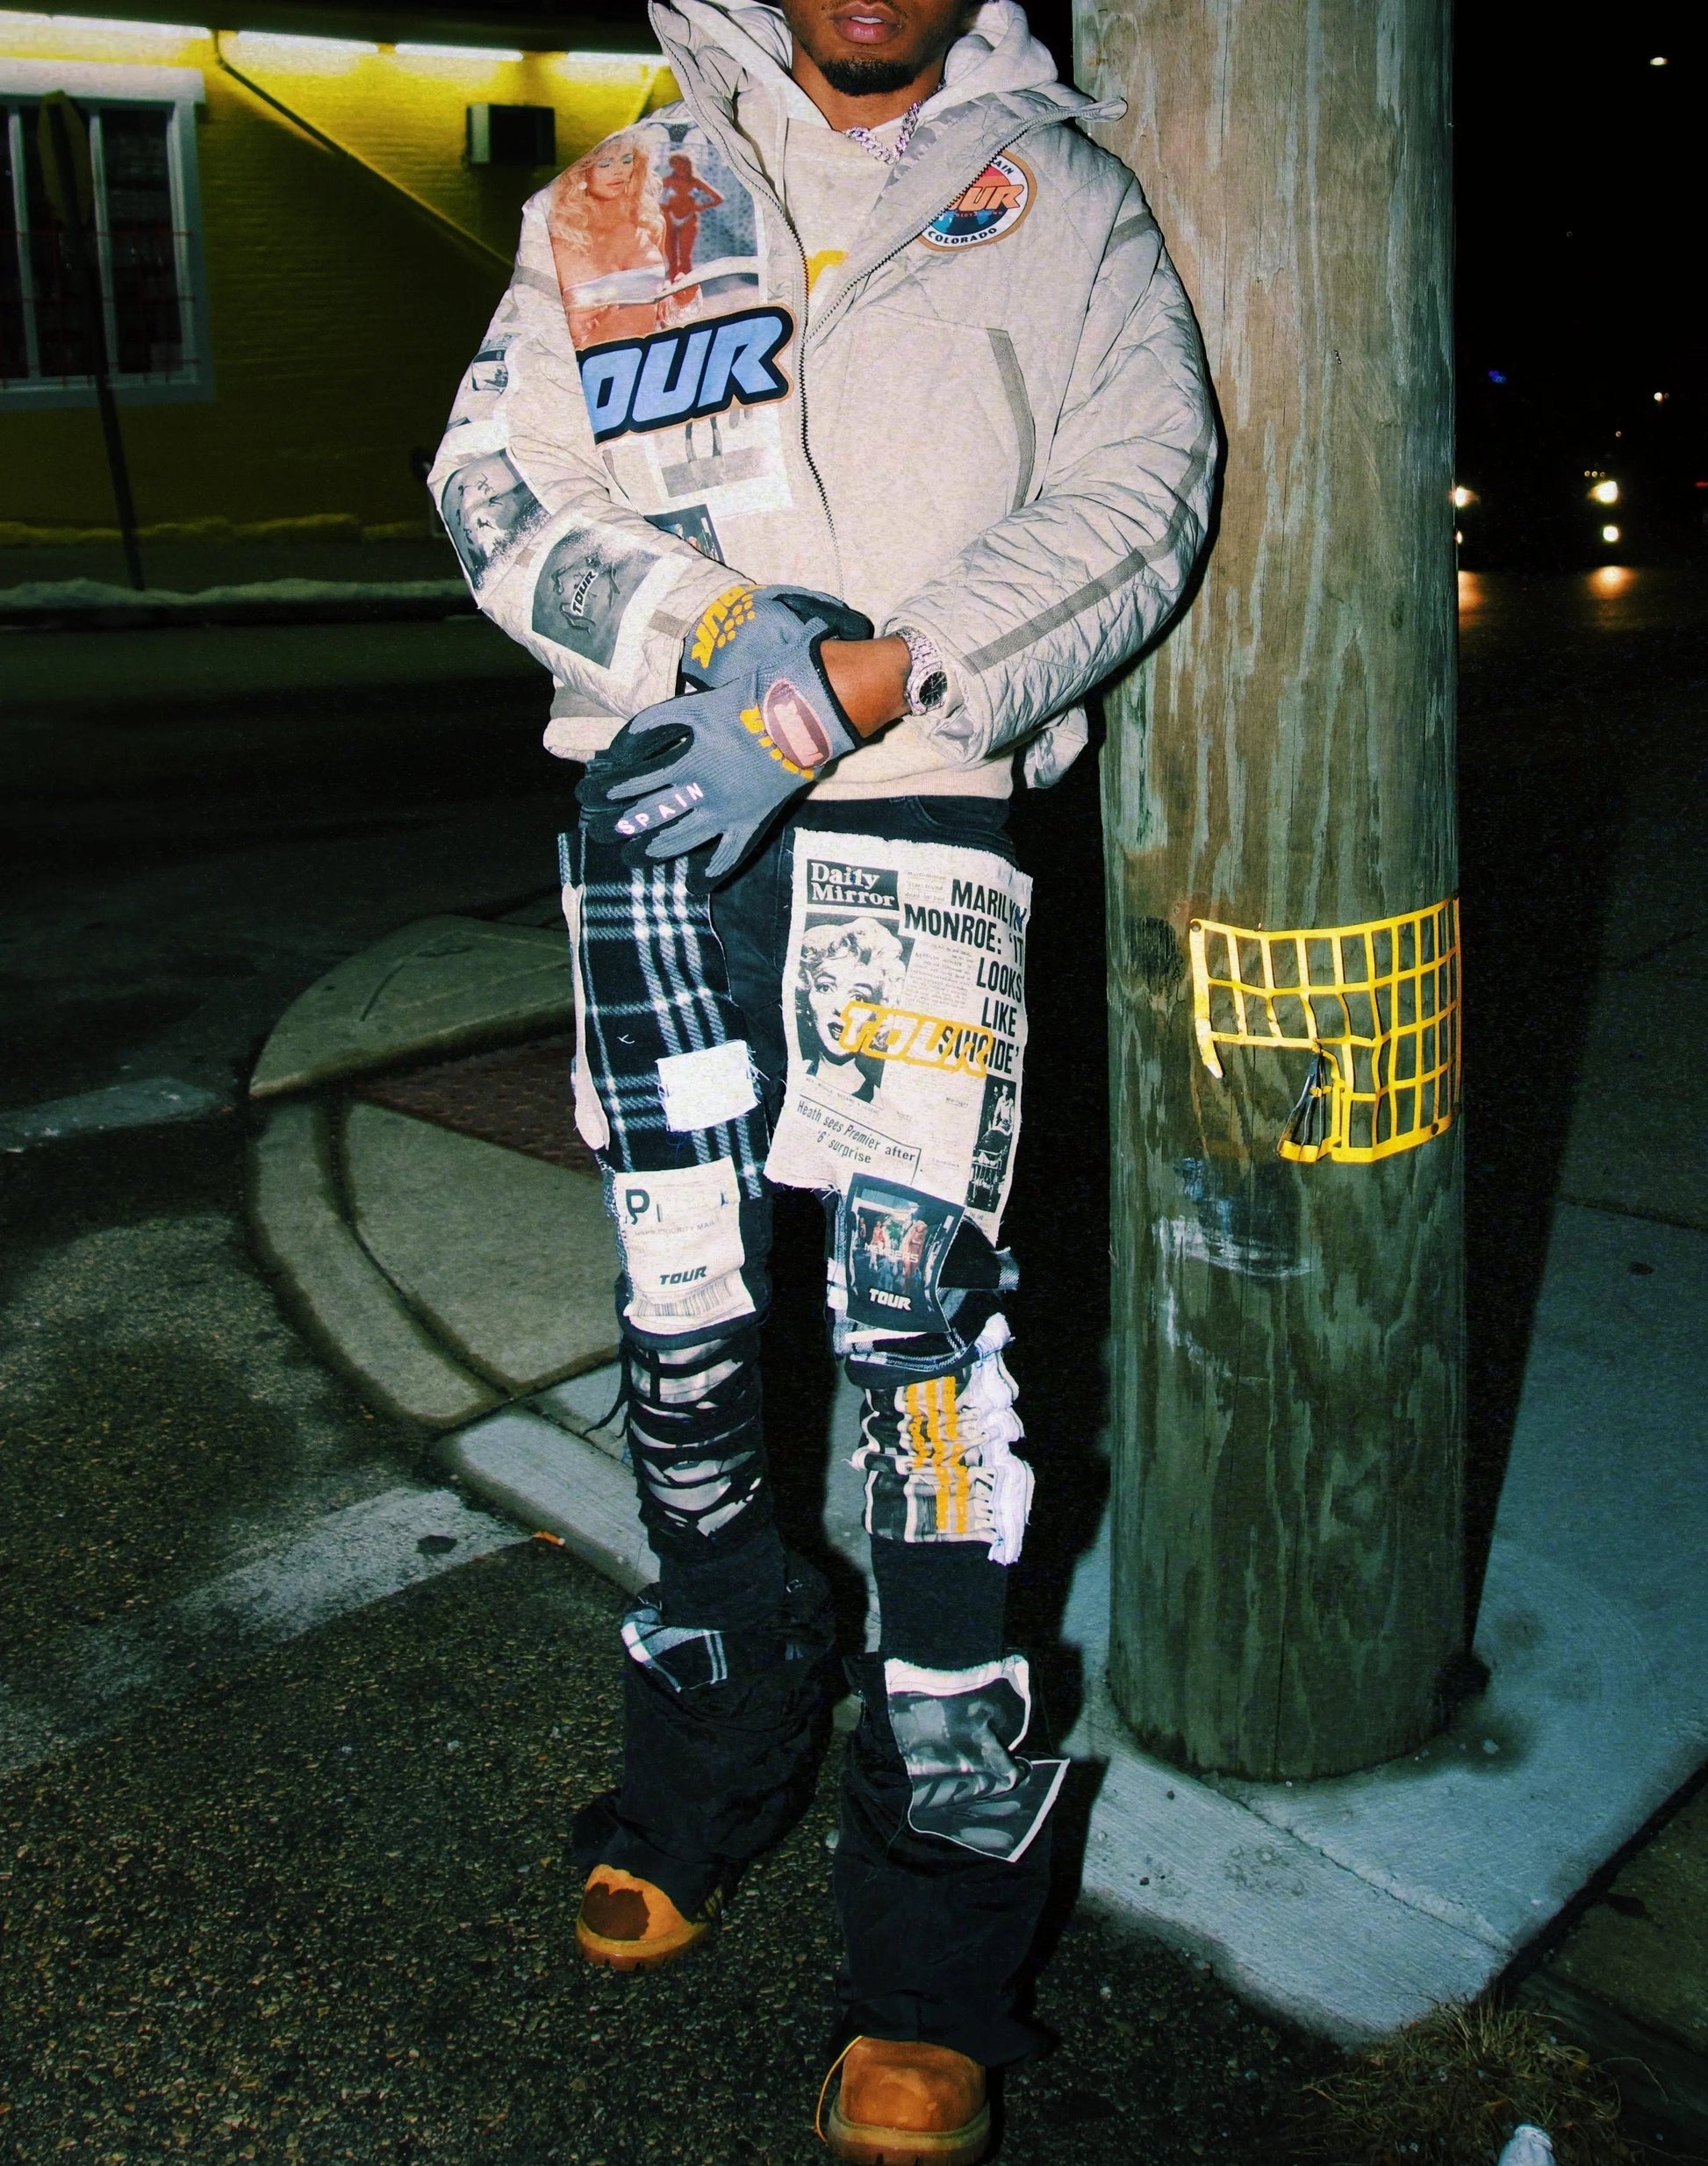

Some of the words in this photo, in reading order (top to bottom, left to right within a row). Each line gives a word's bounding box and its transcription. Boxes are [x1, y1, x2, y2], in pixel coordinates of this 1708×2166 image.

[993, 160, 1015, 175] AIN
[927, 227, 998, 244] COLORADO
[579, 311, 790, 441] OUR
[571, 570, 598, 615] TOUR
[617, 782, 704, 836] SPAIN
[810, 862, 881, 890] Daily
[811, 884, 895, 907] Mirror
[951, 879, 1027, 933] MARILYN
[904, 902, 1002, 954] MONROE:
[976, 957, 1023, 1003] LOOKS
[981, 997, 1017, 1037] LIKE
[838, 1001, 994, 1079] TOUR
[797, 1100, 822, 1122] Heath
[823, 1115, 843, 1132] sees
[843, 1123, 881, 1151] Premier
[885, 1144, 916, 1161] after
[816, 1130, 830, 1144] '6'
[829, 1138, 872, 1164] surprise
[657, 1225, 694, 1236] PRIORITY
[697, 1220, 715, 1230] MAIL
[865, 1242, 919, 1264] MEMBERS
[660, 1266, 707, 1286] TOUR
[868, 1287, 913, 1311] TOUR
